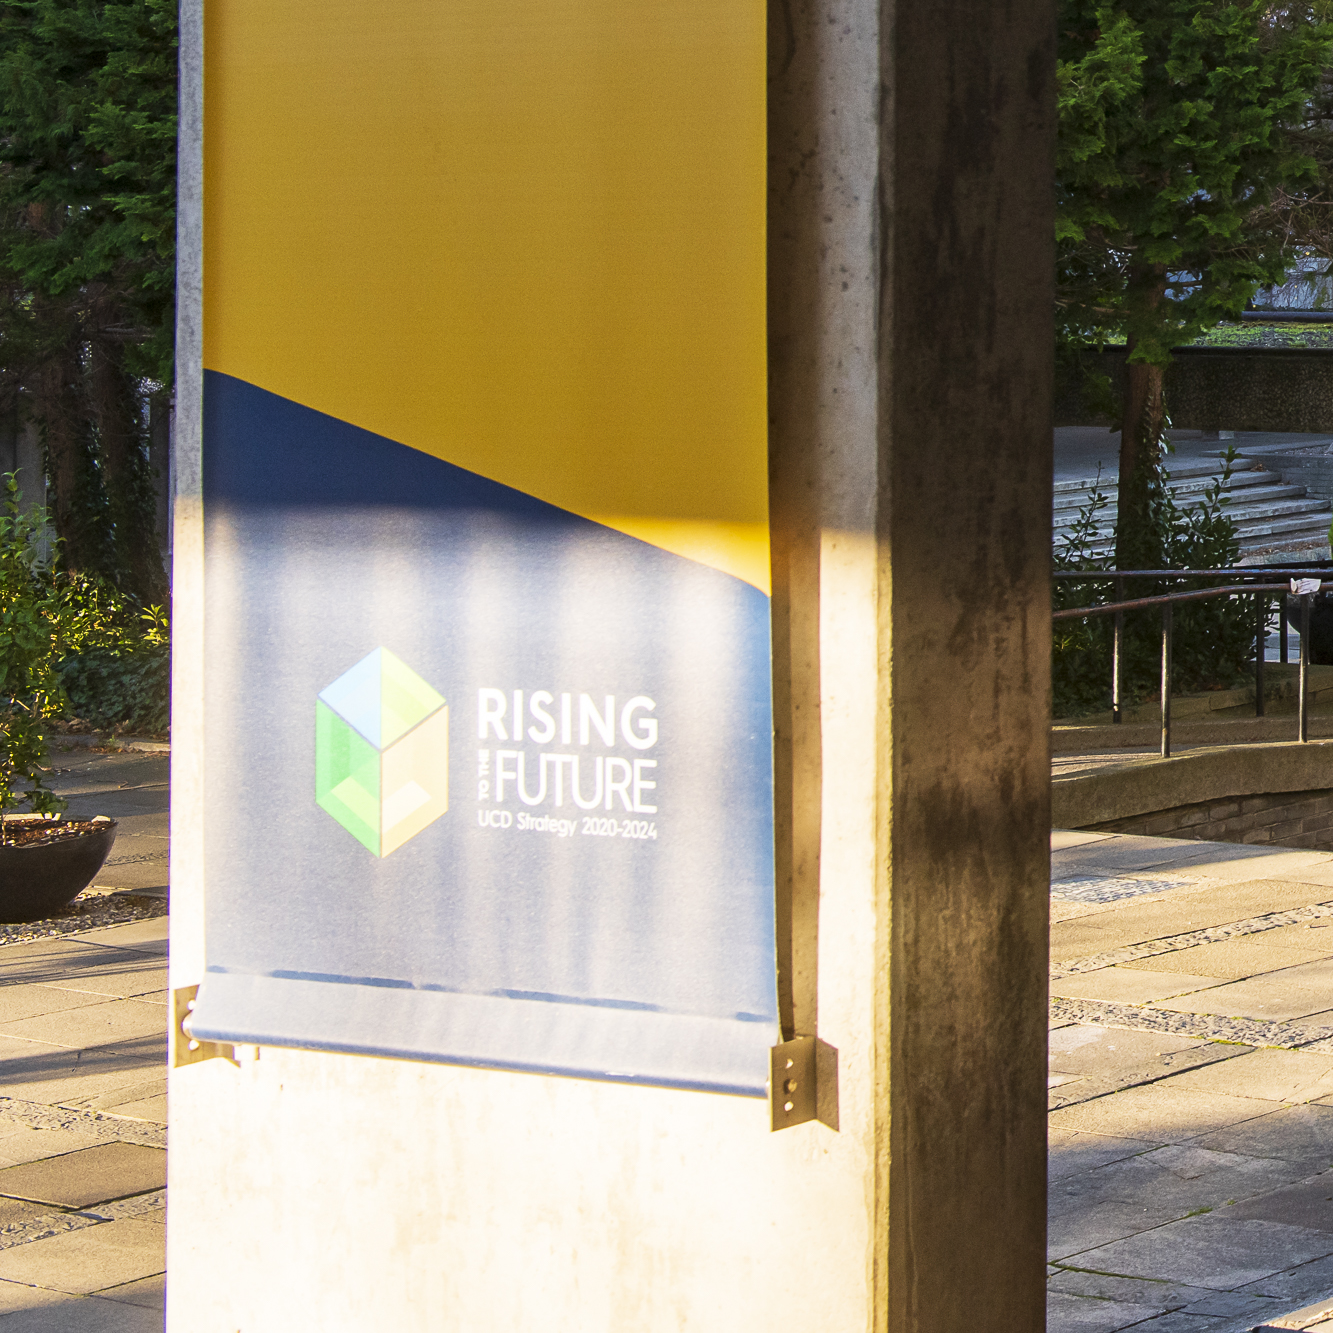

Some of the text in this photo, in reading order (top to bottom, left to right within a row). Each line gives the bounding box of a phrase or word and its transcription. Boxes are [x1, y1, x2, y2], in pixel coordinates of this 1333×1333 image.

[477, 688, 658, 750] RISING
[478, 749, 490, 801] TO THE
[496, 750, 658, 814] FUTURE
[477, 810, 658, 840] UCD Strategy 2020-2024
